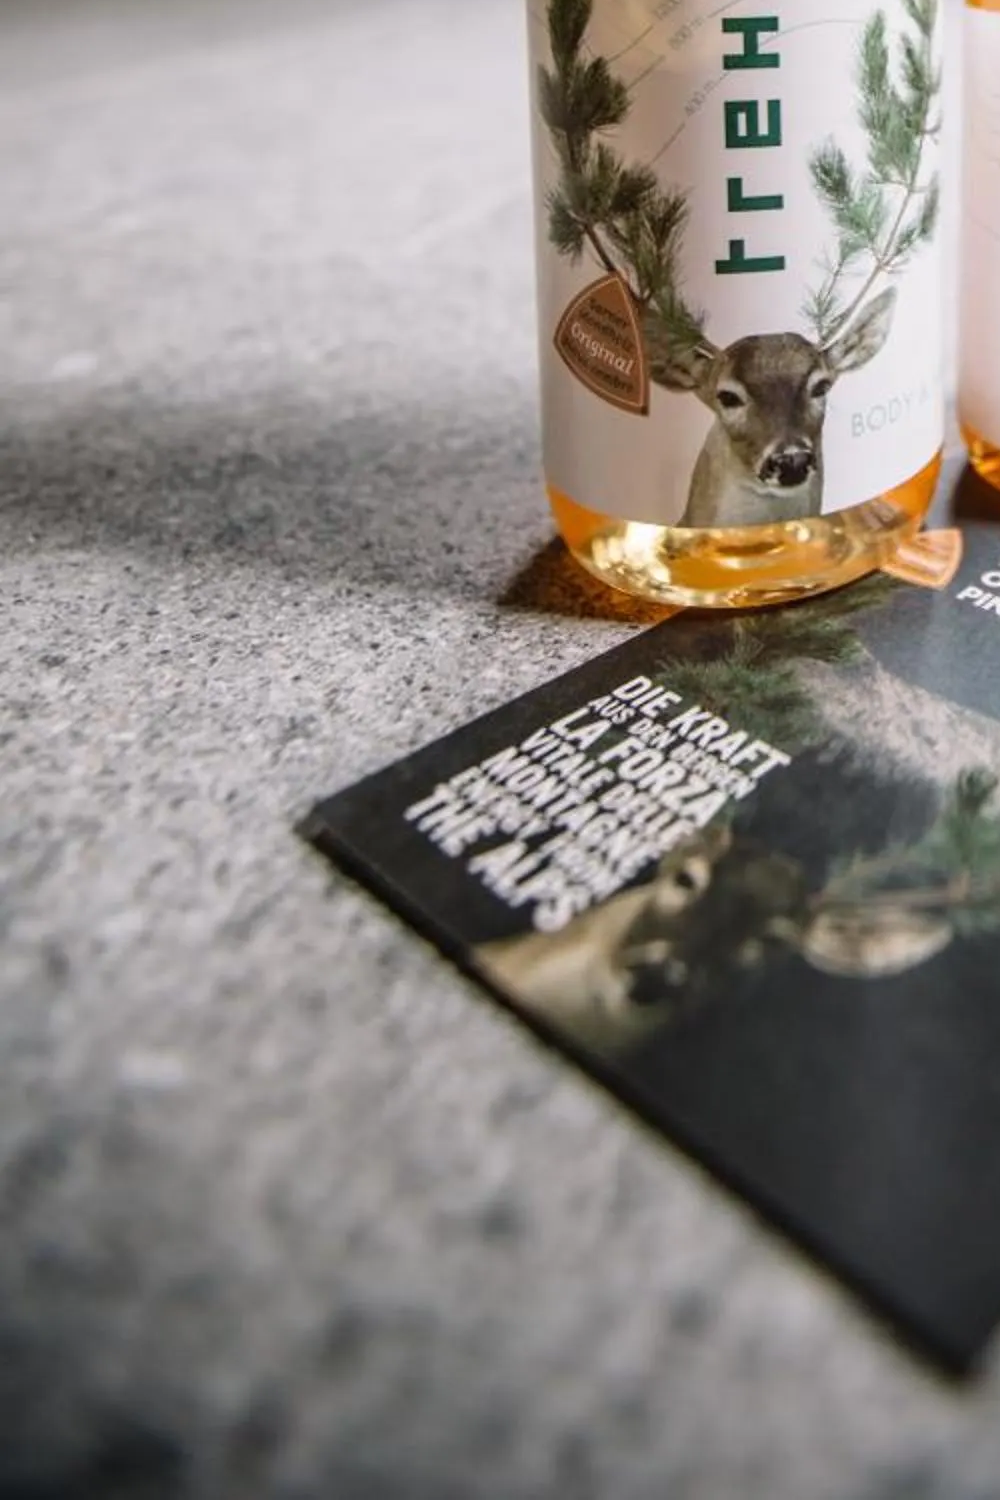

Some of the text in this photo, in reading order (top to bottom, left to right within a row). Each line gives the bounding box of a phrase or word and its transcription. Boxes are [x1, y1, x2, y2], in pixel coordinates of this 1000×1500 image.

[570, 322, 634, 376] Original
[851, 390, 914, 439] BODY
[549, 706, 728, 829] LA FORZA
[588, 695, 636, 725] AUS
[628, 717, 679, 750] DEN
[612, 675, 792, 780] DIE KRAFT
[480, 746, 663, 882] MONTAGNE
[519, 726, 697, 852] VITALE DELLE
[402, 781, 593, 933] THE ALPS
